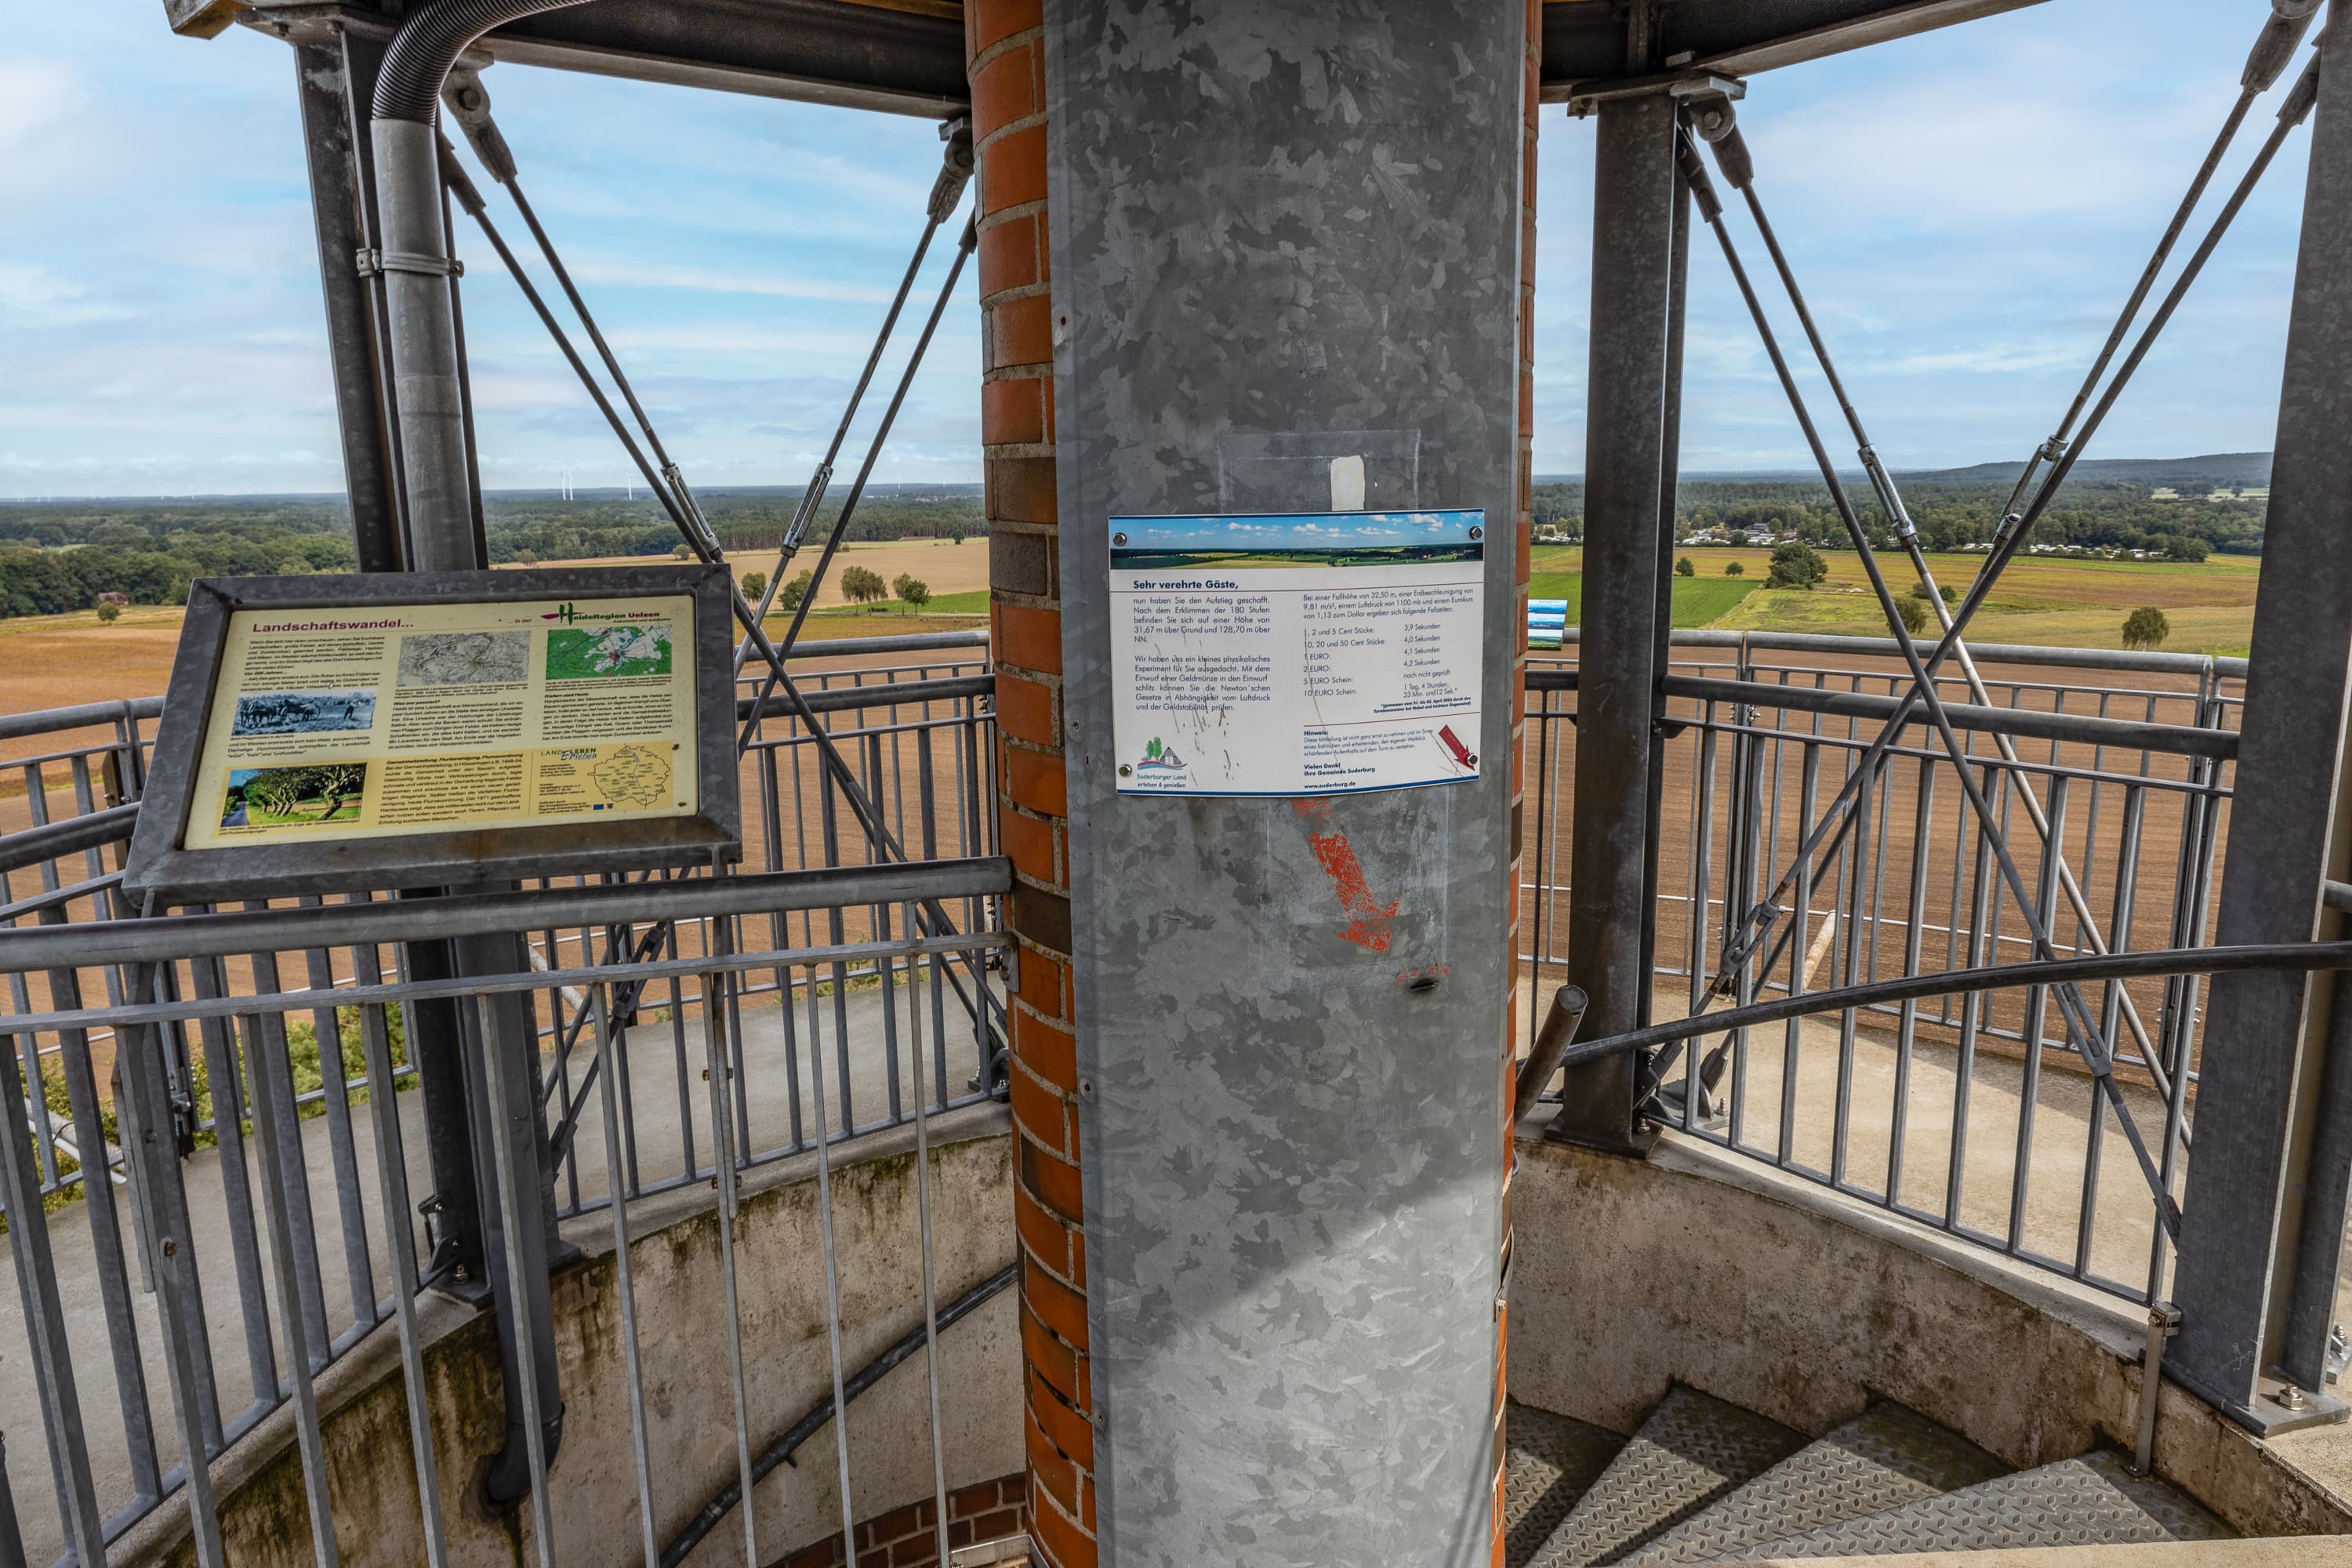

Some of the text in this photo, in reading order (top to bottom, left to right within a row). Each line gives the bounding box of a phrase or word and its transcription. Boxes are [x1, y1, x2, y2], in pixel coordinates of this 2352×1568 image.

[1134, 580, 1239, 590] Sehr verehrte Gäste,
[1189, 596, 1202, 604] den
[1206, 596, 1233, 605] Aufstieg
[1237, 596, 1269, 605] geschafft.
[1249, 605, 1270, 614] Stufen
[1303, 603, 1318, 612] 9,81
[1367, 609, 1389, 618] ergeben
[1403, 607, 1426, 616] folgende
[252, 619, 414, 633] Landschaftswandel...
[1305, 641, 1315, 650] 10,
[1223, 655, 1270, 664] physikalisches
[1135, 665, 1171, 674] Experiment
[1198, 665, 1239, 674] ausgedacht.
[1432, 670, 1450, 678] geprüft
[1174, 694, 1218, 702] Abhängigkeit
[1211, 703, 1235, 712] prüfen.
